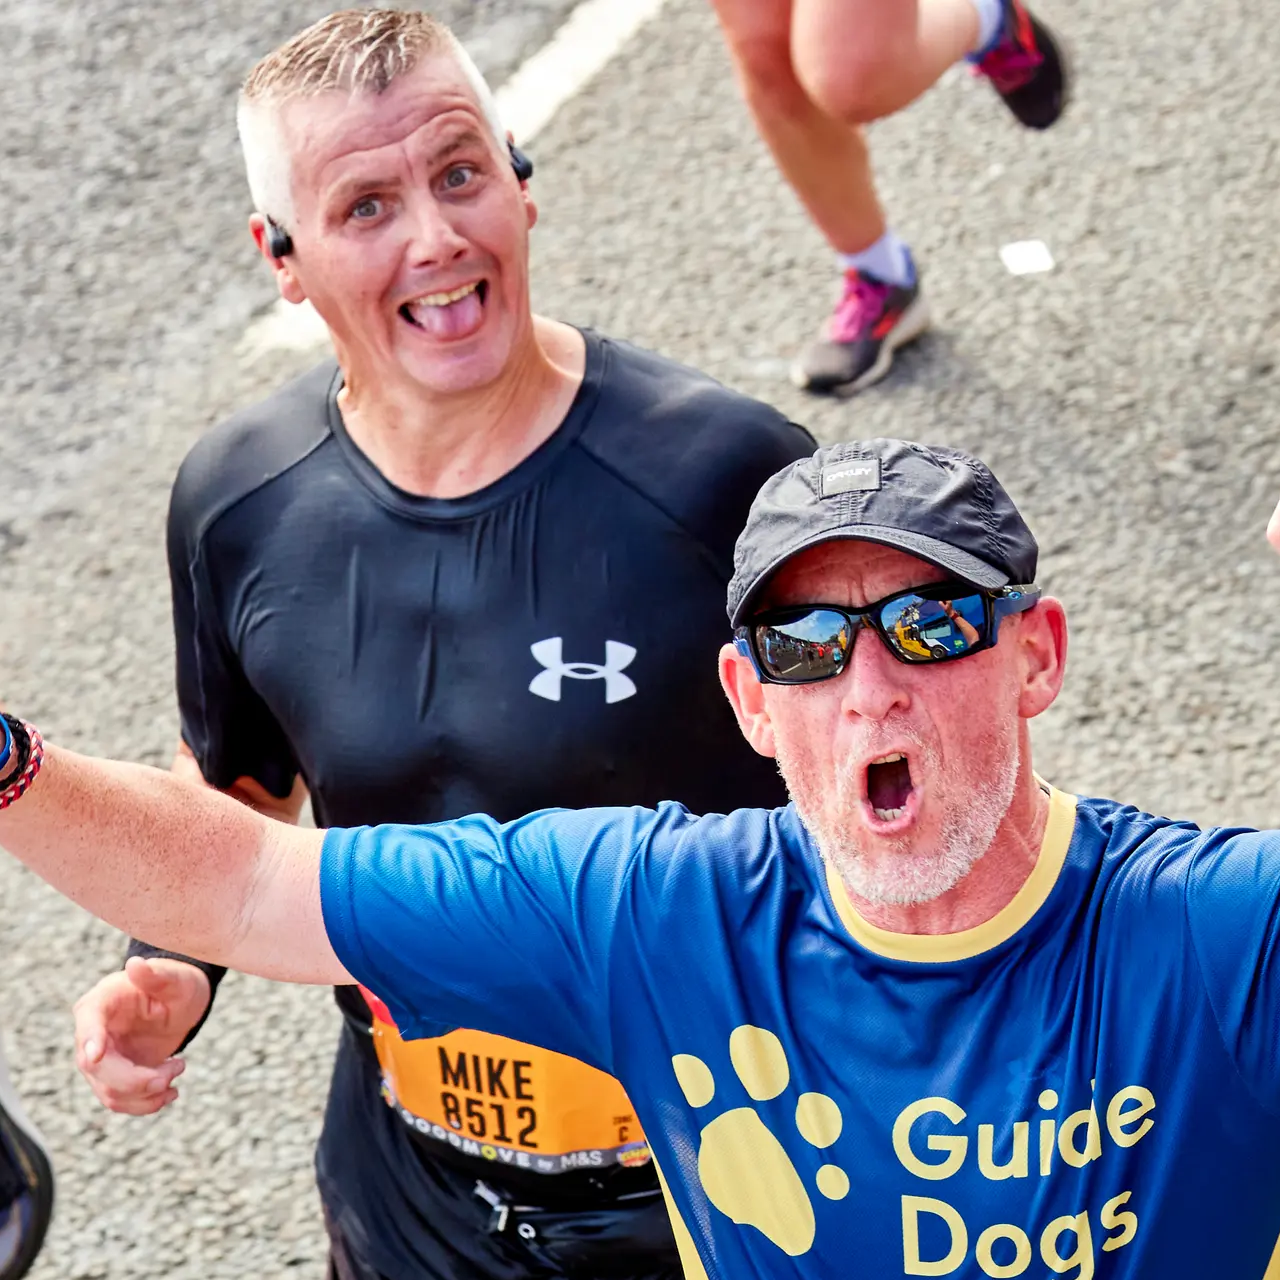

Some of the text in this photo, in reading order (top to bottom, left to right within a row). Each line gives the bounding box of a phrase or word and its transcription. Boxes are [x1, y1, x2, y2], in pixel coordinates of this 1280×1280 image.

[437, 1045, 535, 1101] MIKE
[440, 1091, 539, 1149] 8512
[891, 1078, 1156, 1181] Guide
[560, 1150, 603, 1169] M&S
